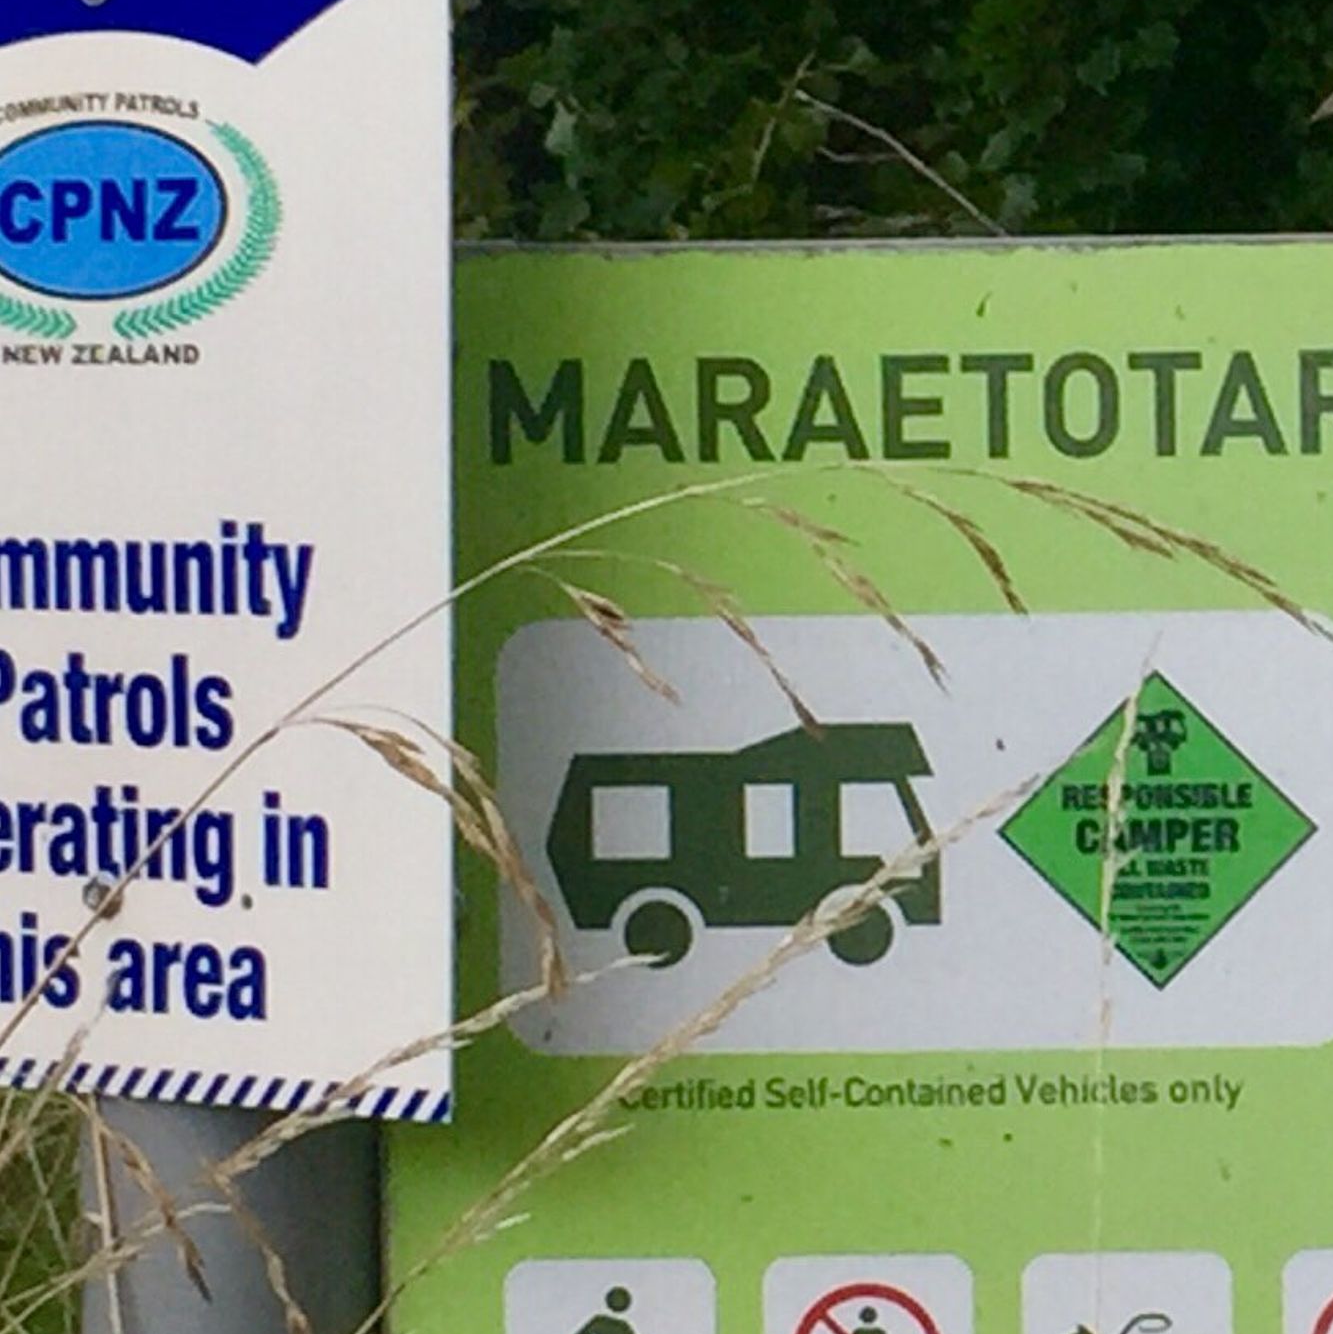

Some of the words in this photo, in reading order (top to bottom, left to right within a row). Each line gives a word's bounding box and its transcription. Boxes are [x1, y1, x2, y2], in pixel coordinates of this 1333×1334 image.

[0, 92, 108, 124] OMMUNITY
[114, 92, 199, 120] PATROLS
[2, 178, 199, 245] CPNZ
[2, 343, 63, 365] NEW
[71, 343, 200, 365] ZEALAND
[263, 791, 330, 890] in
[107, 935, 268, 1022] area
[766, 1073, 1005, 1109] Self-Contained
[1015, 1073, 1158, 1106] Vehicles
[1169, 1074, 1244, 1110] only
